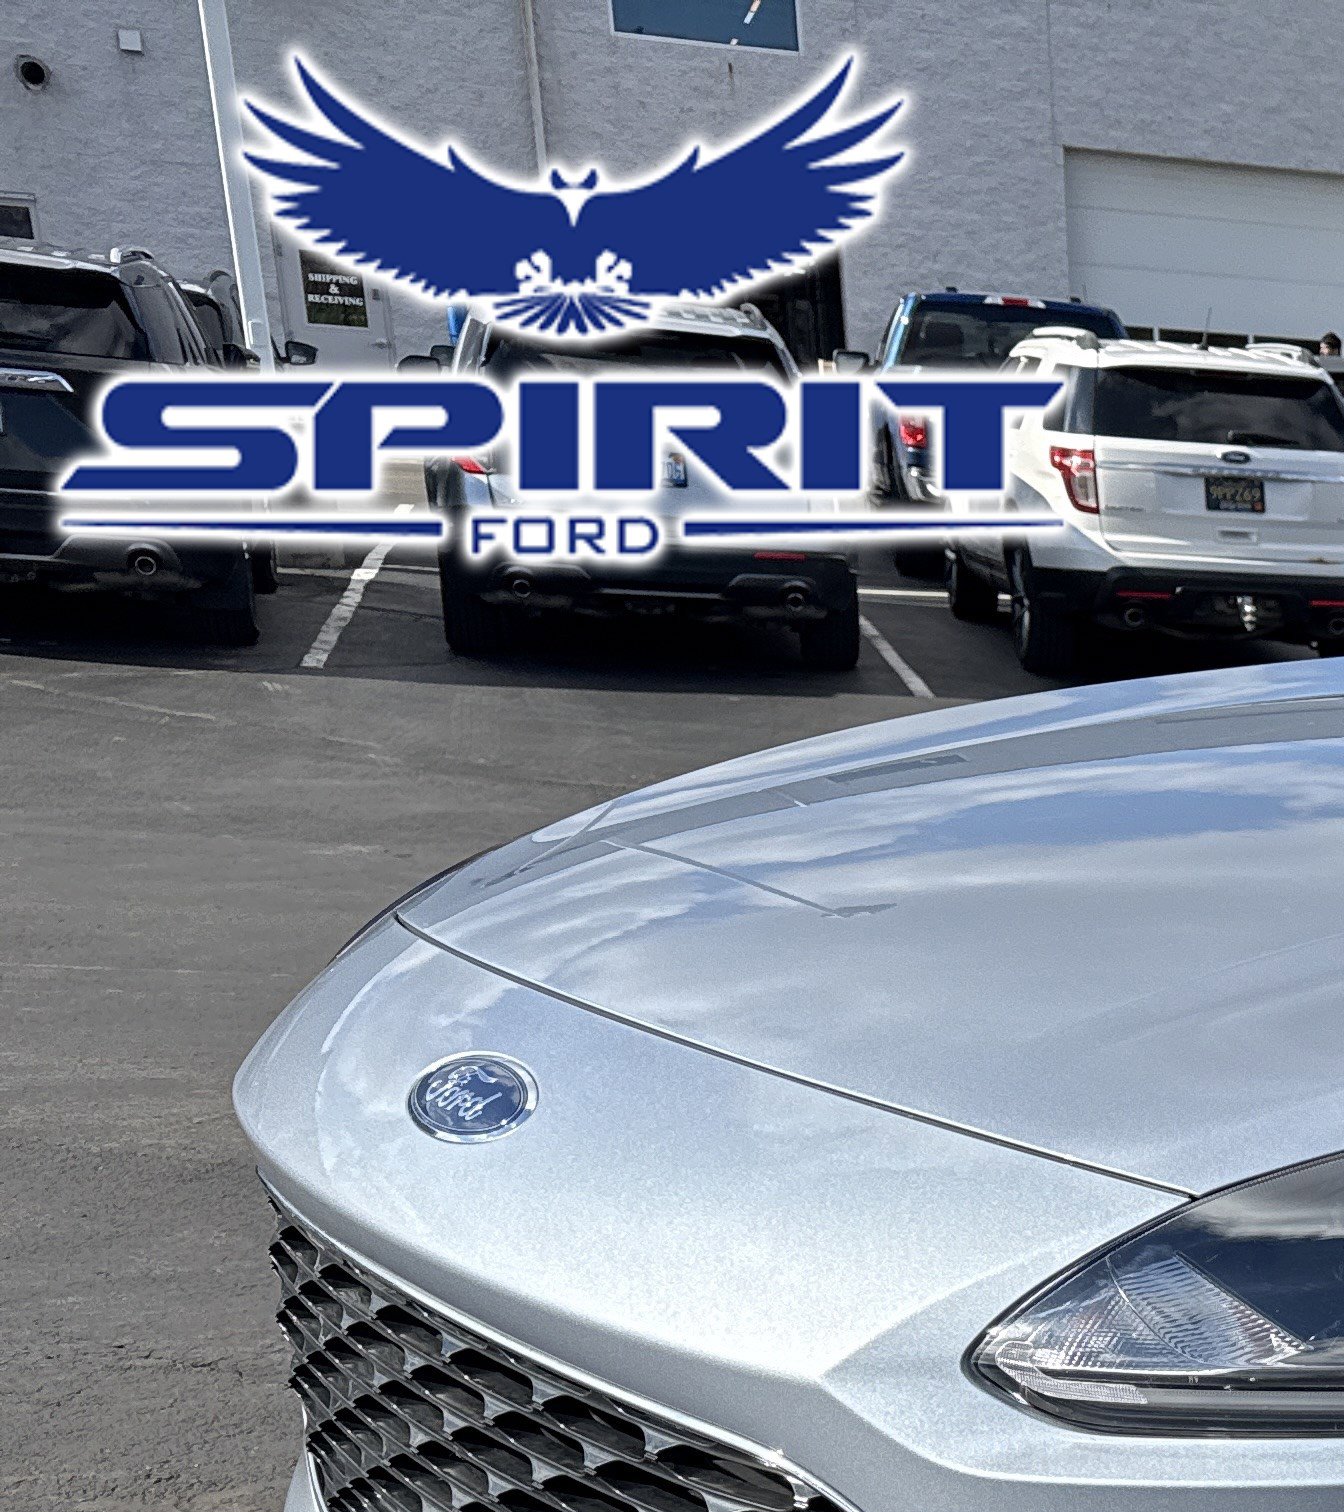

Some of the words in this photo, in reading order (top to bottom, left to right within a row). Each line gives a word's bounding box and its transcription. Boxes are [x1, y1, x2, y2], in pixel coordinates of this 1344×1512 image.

[308, 272, 358, 285] SHIPPING
[328, 283, 340, 294] &
[307, 294, 364, 306] RECEIVING
[425, 1065, 503, 1121] Ford
